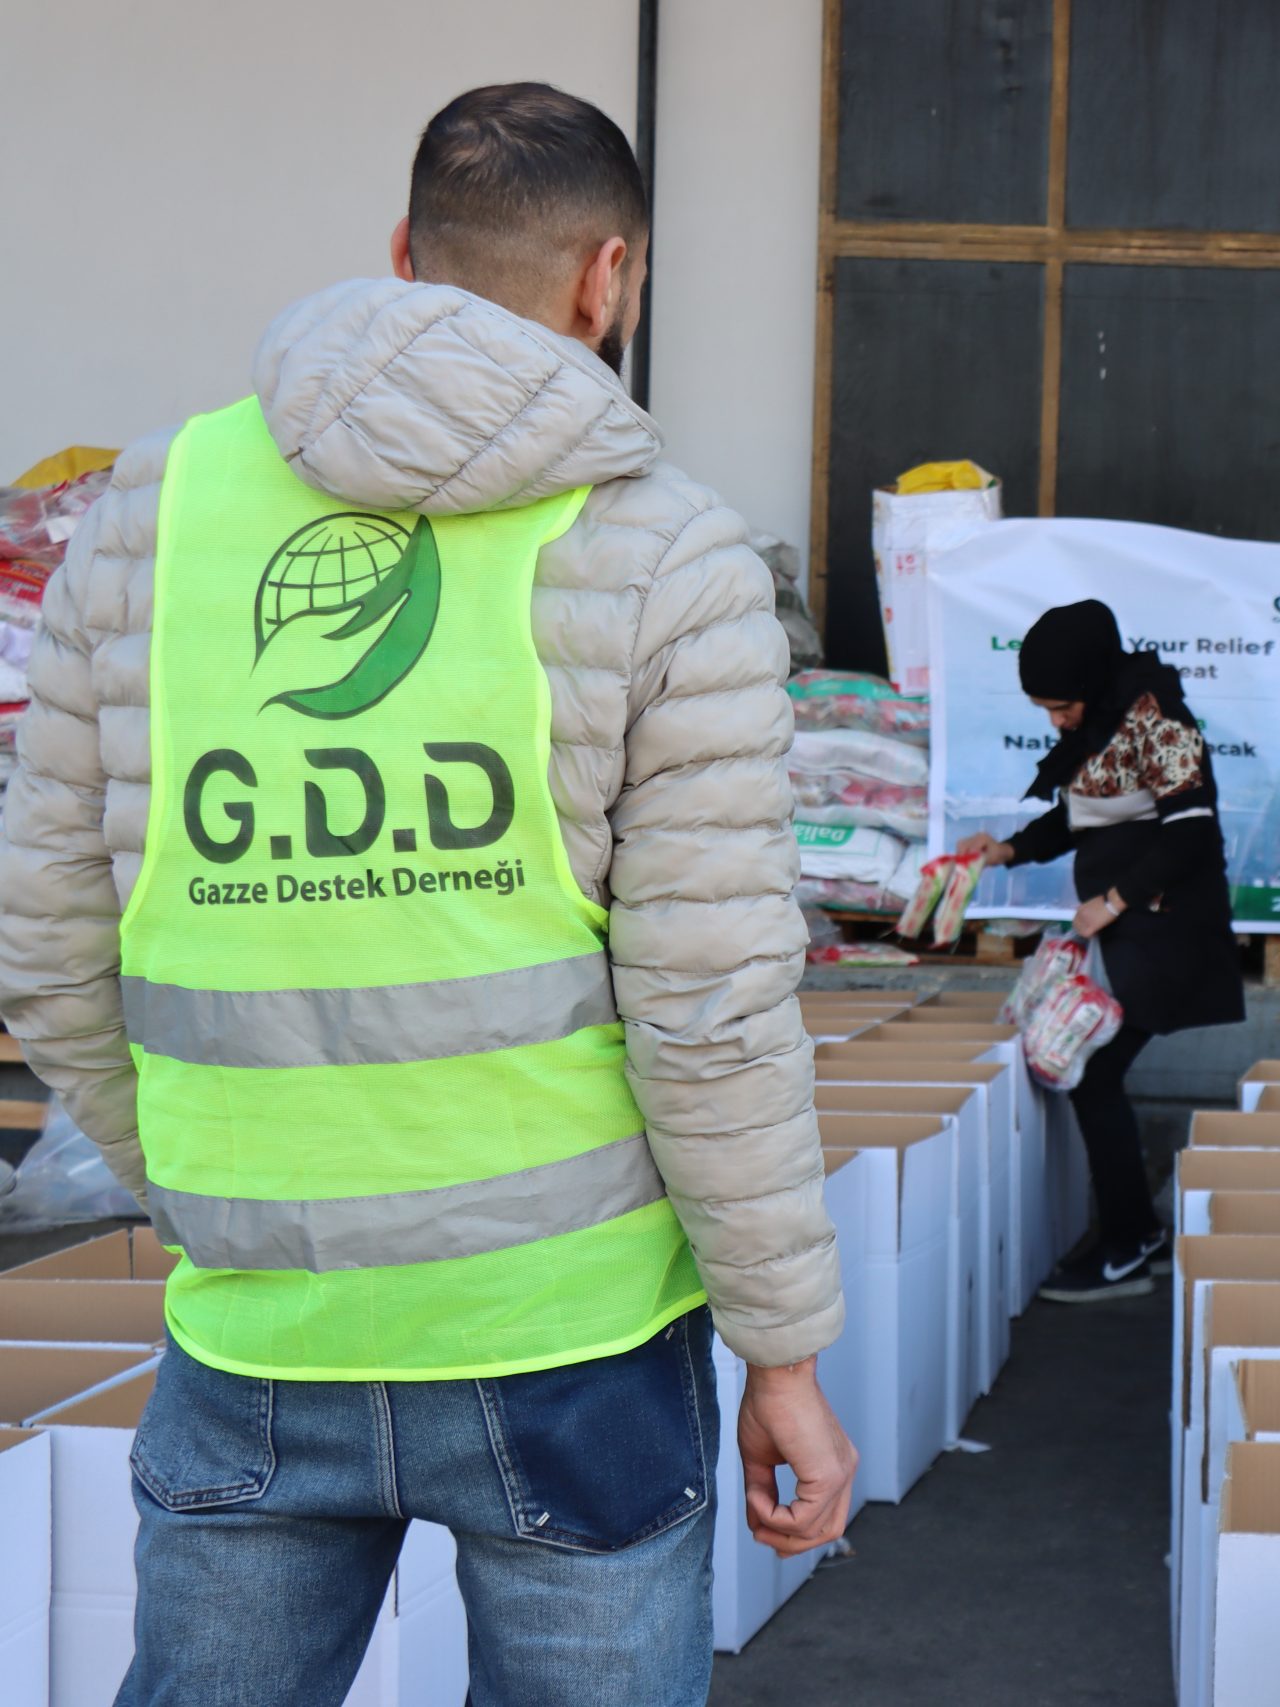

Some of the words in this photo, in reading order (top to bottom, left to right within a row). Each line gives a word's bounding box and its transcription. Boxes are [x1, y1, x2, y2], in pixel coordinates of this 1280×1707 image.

[1128, 637, 1189, 653] Your
[1196, 637, 1276, 655] Relief
[184, 742, 515, 864] G.D.D
[188, 876, 268, 905] Gazze
[276, 869, 387, 902] Destek
[392, 859, 525, 896] Derneği
